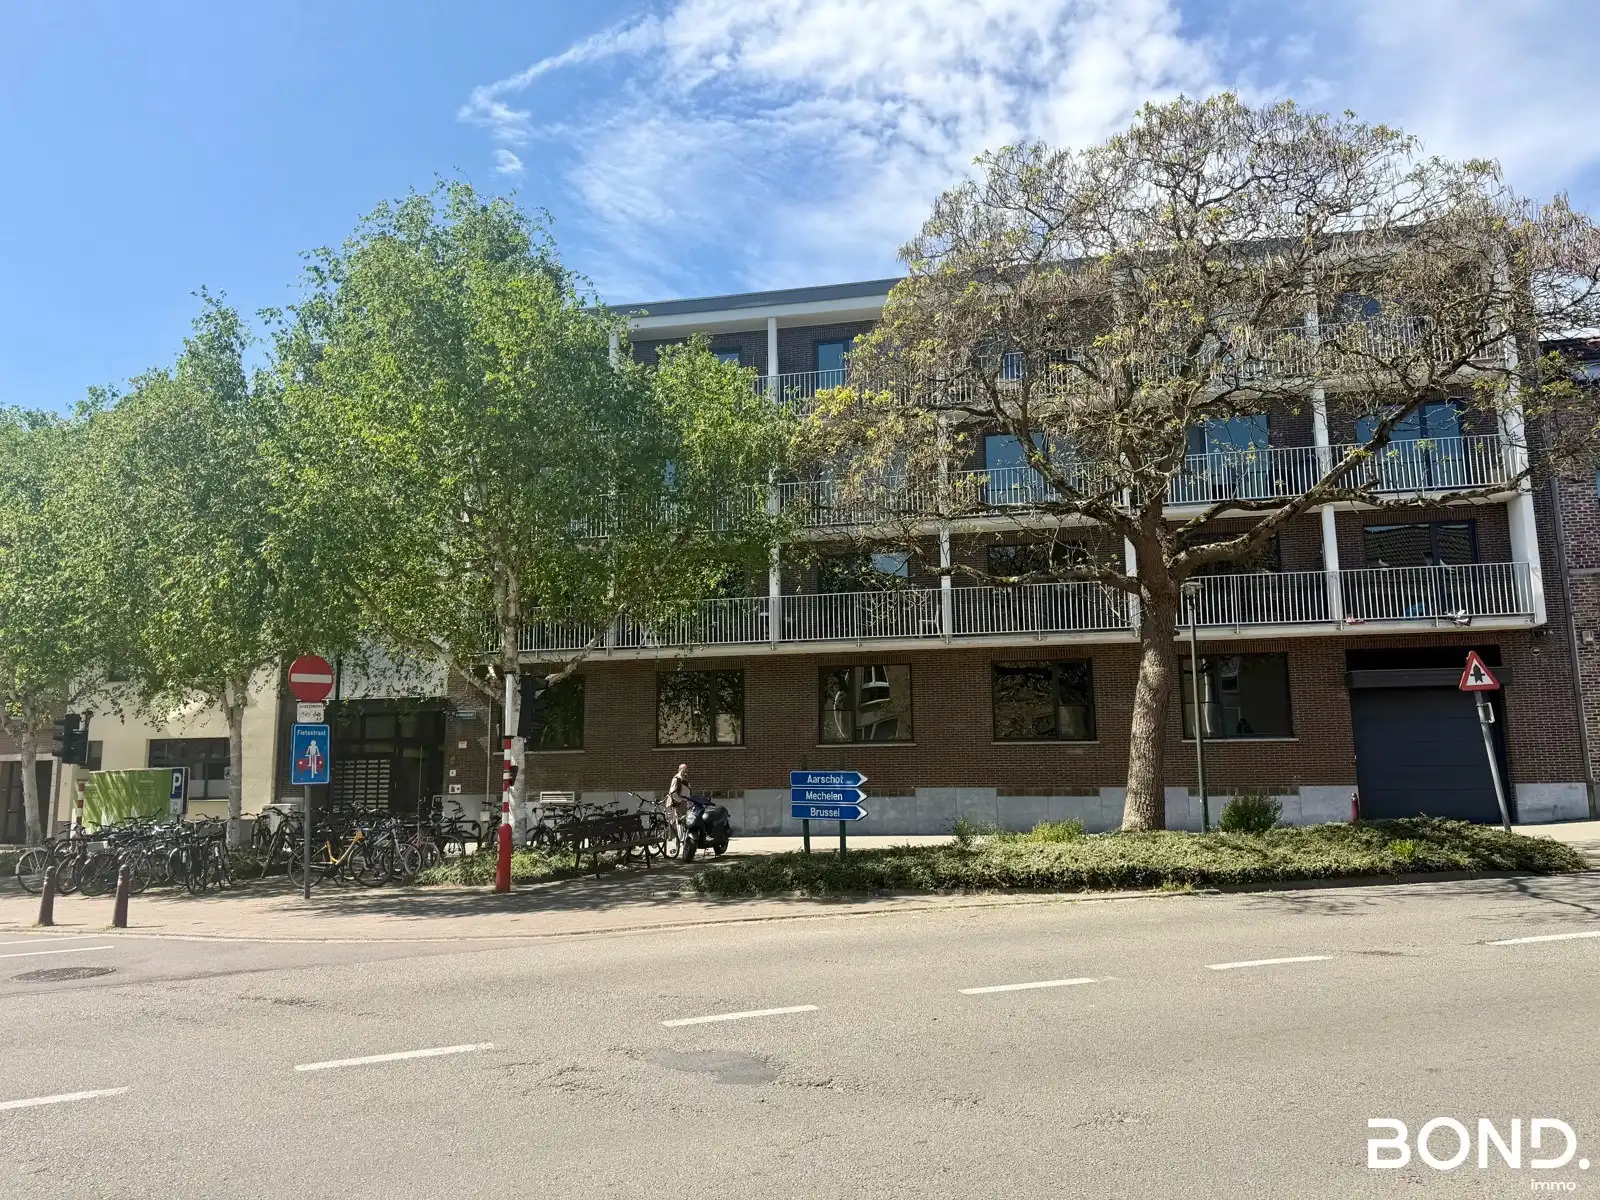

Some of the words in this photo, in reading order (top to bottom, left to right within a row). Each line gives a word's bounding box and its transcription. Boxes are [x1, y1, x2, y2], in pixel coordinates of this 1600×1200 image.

[171, 772, 182, 795] P
[807, 774, 844, 784] Aarschot
[805, 790, 843, 801] Mechelen
[810, 807, 840, 817] Brussel
